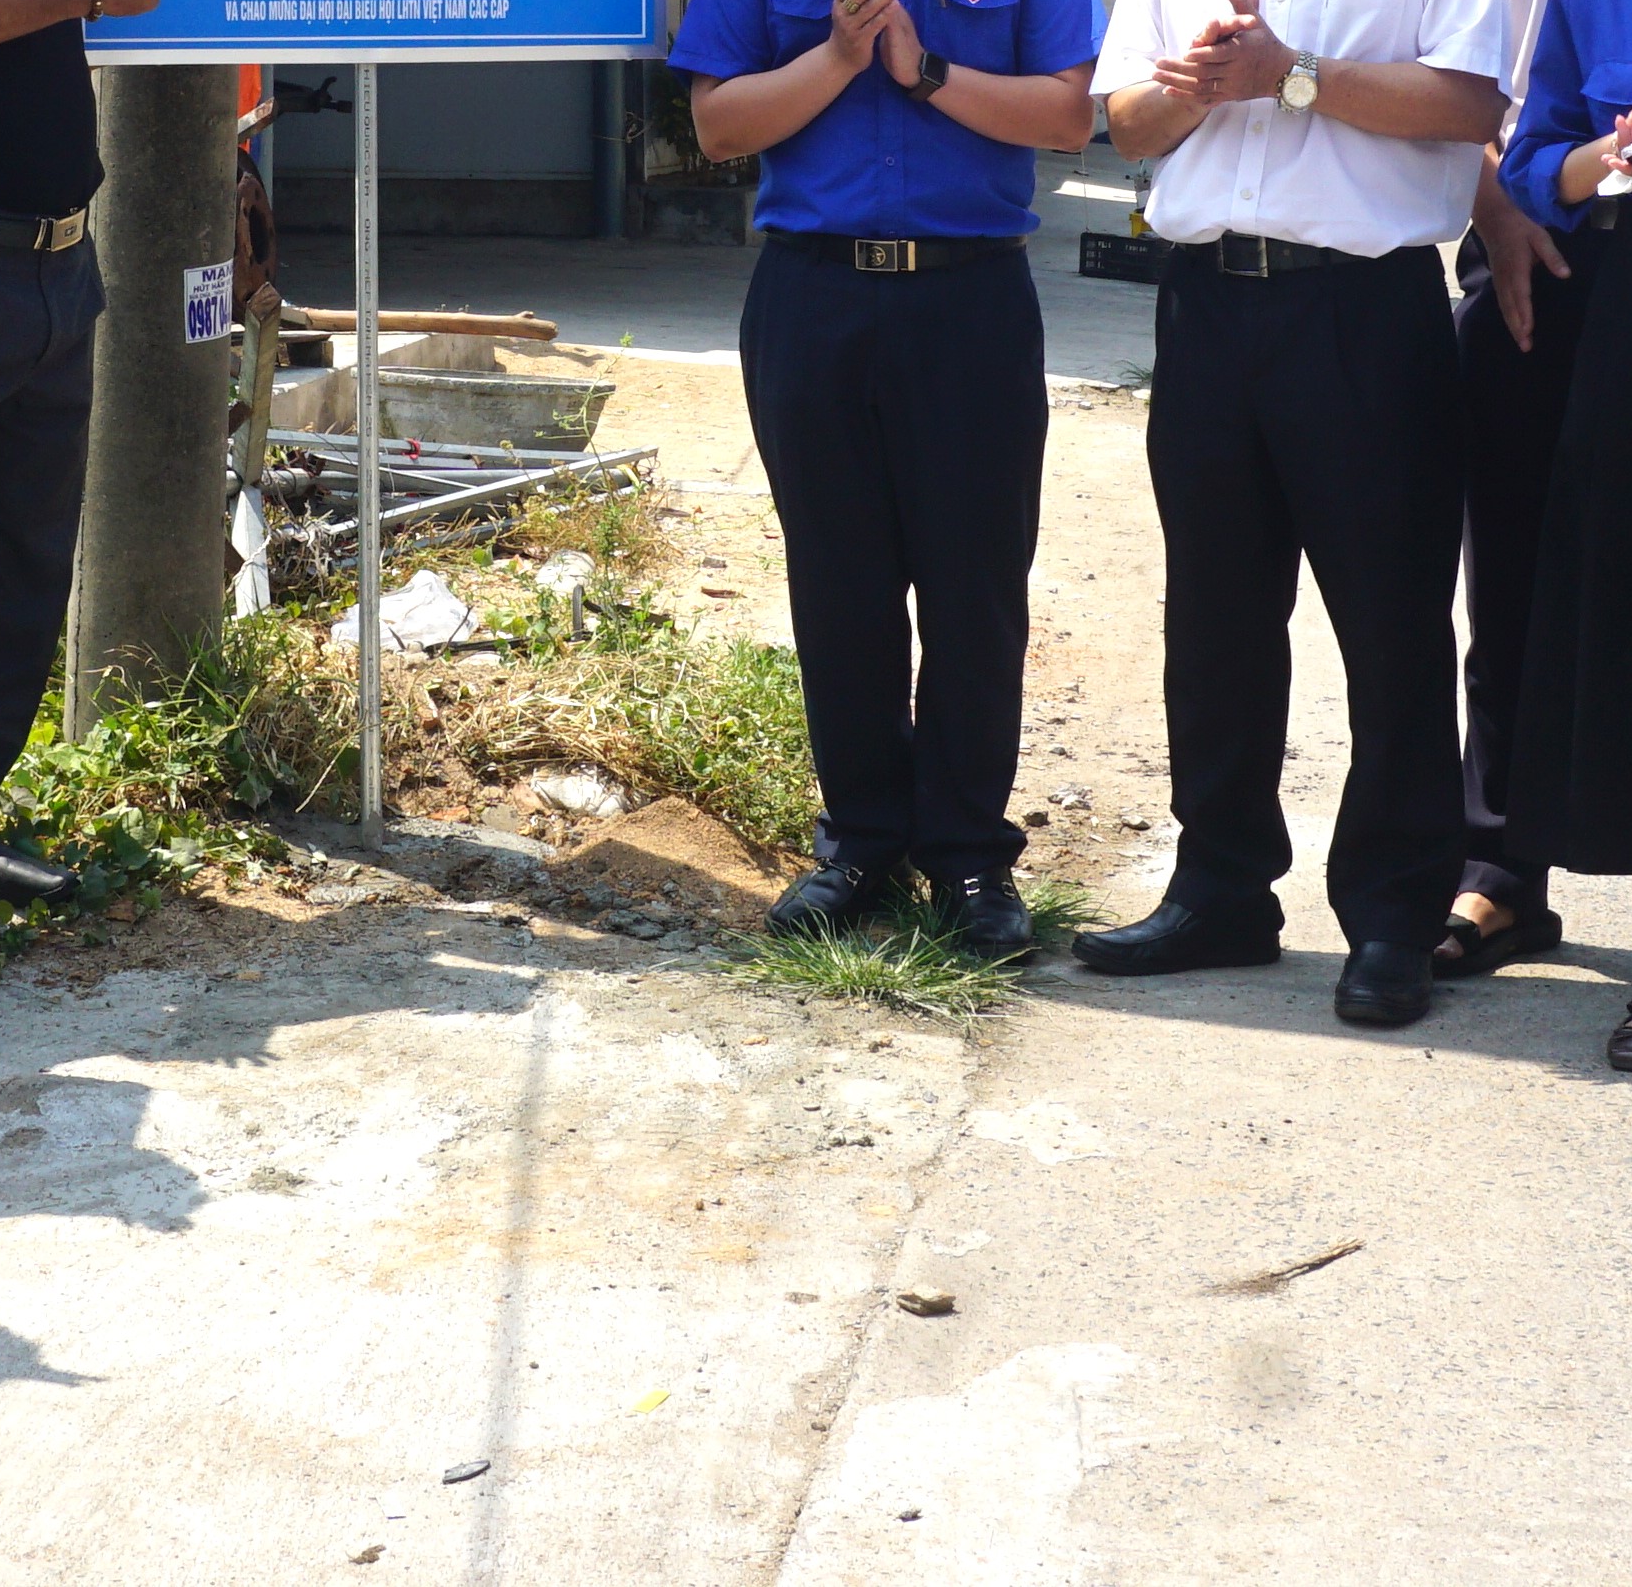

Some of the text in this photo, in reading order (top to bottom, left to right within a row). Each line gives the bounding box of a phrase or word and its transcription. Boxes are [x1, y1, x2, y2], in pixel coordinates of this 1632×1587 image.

[299, 0, 316, 25] ĐẠI
[336, 0, 353, 25] ĐẠI
[397, 0, 420, 20] LHTN
[445, 0, 467, 20] NAM
